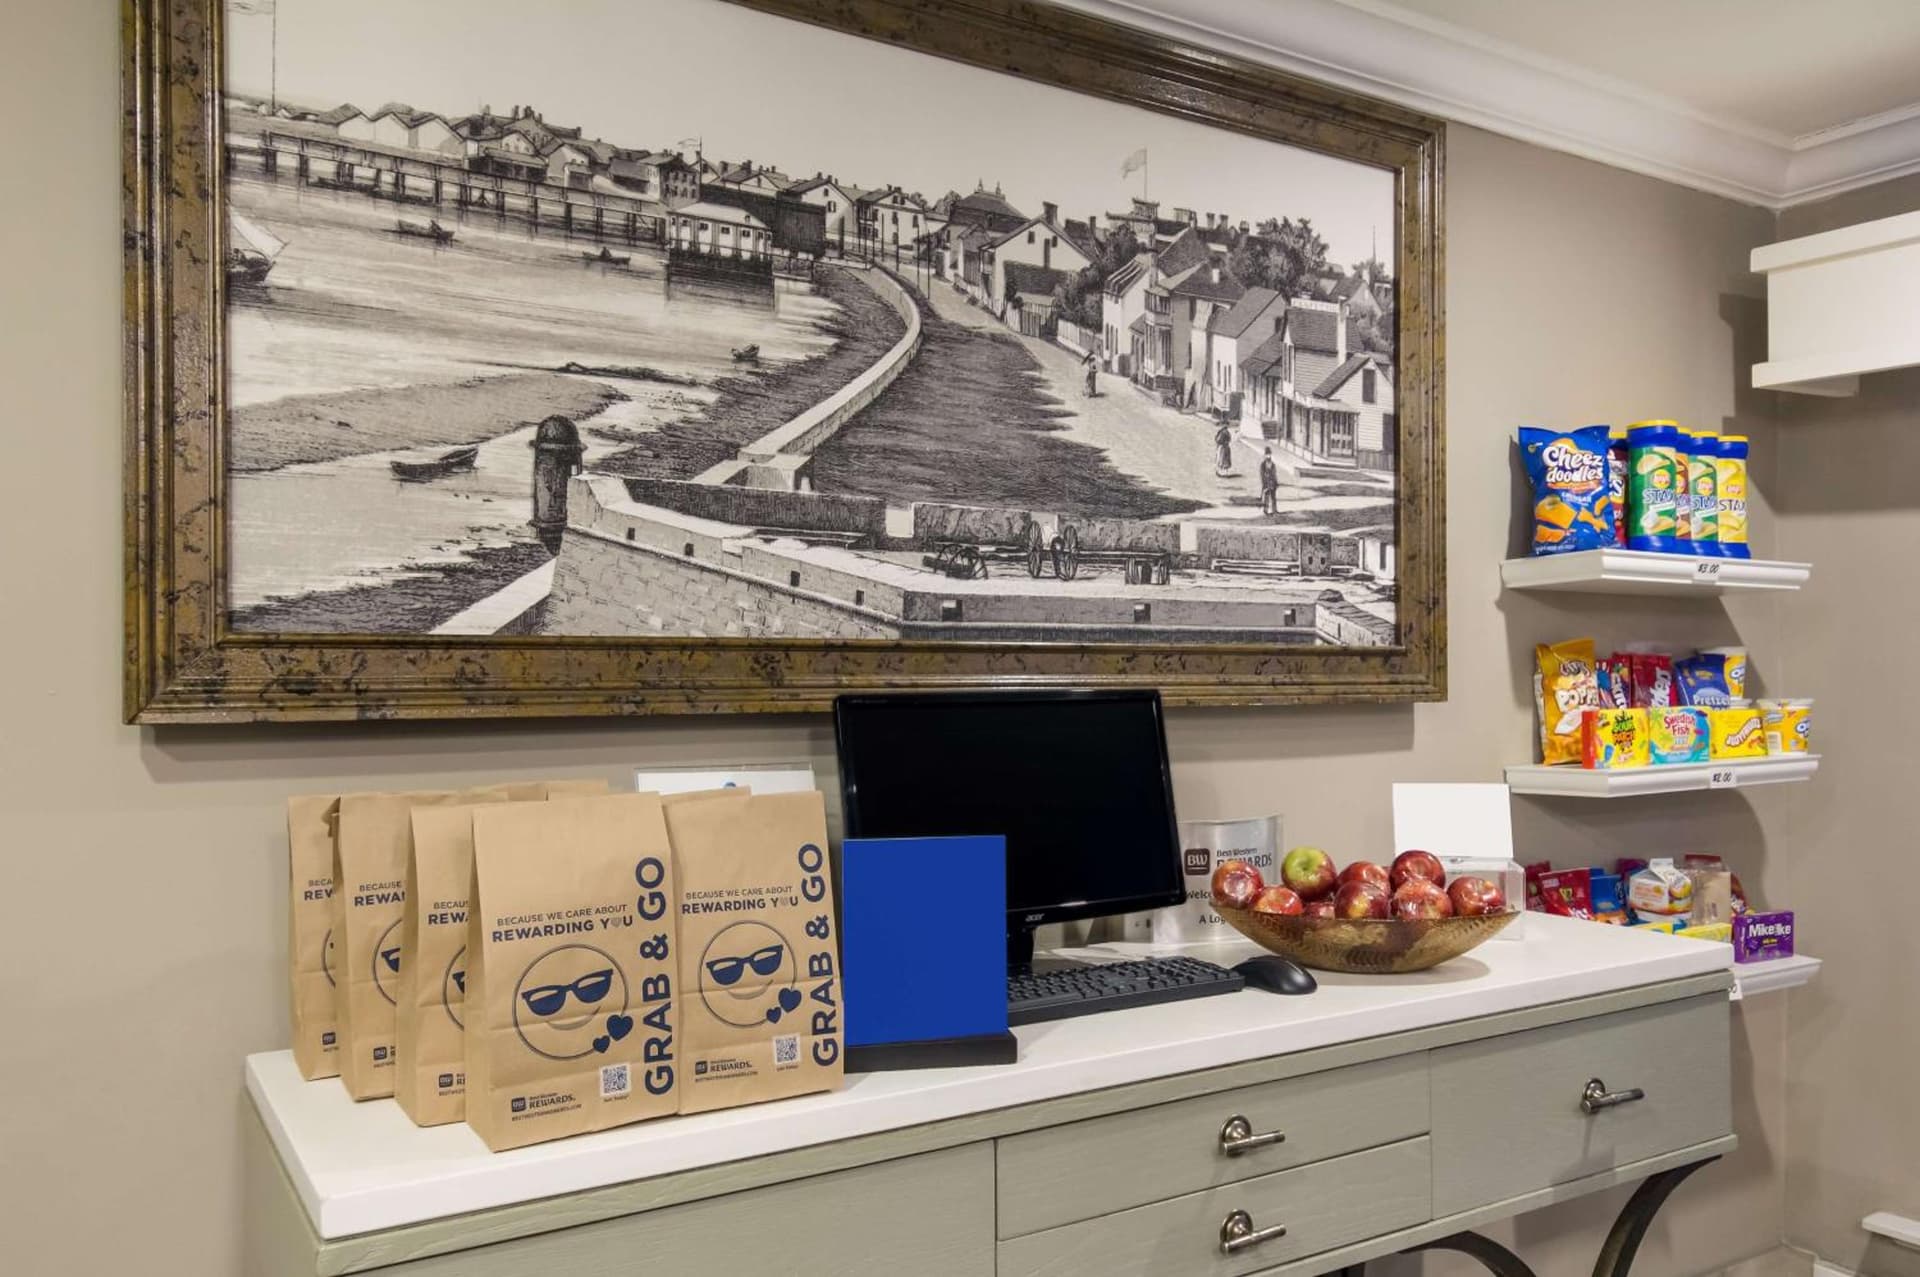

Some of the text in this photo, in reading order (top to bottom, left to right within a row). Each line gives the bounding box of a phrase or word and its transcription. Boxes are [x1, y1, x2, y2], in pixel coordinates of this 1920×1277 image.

[1543, 446, 1603, 469] Cheez
[1546, 466, 1603, 482] doodles
[1187, 854, 1208, 866] BW
[686, 885, 793, 899] BECAUSE WE CARE ABOUT
[682, 898, 766, 914] REWARDING
[497, 904, 627, 926] BECAUSE WE CARE ABOUT
[1199, 914, 1207, 924] A
[492, 919, 594, 942] REWARDING
[1749, 924, 1774, 937] Mike
[798, 843, 839, 1067] GRAB & GO
[635, 857, 674, 1095] GRAB & GO
